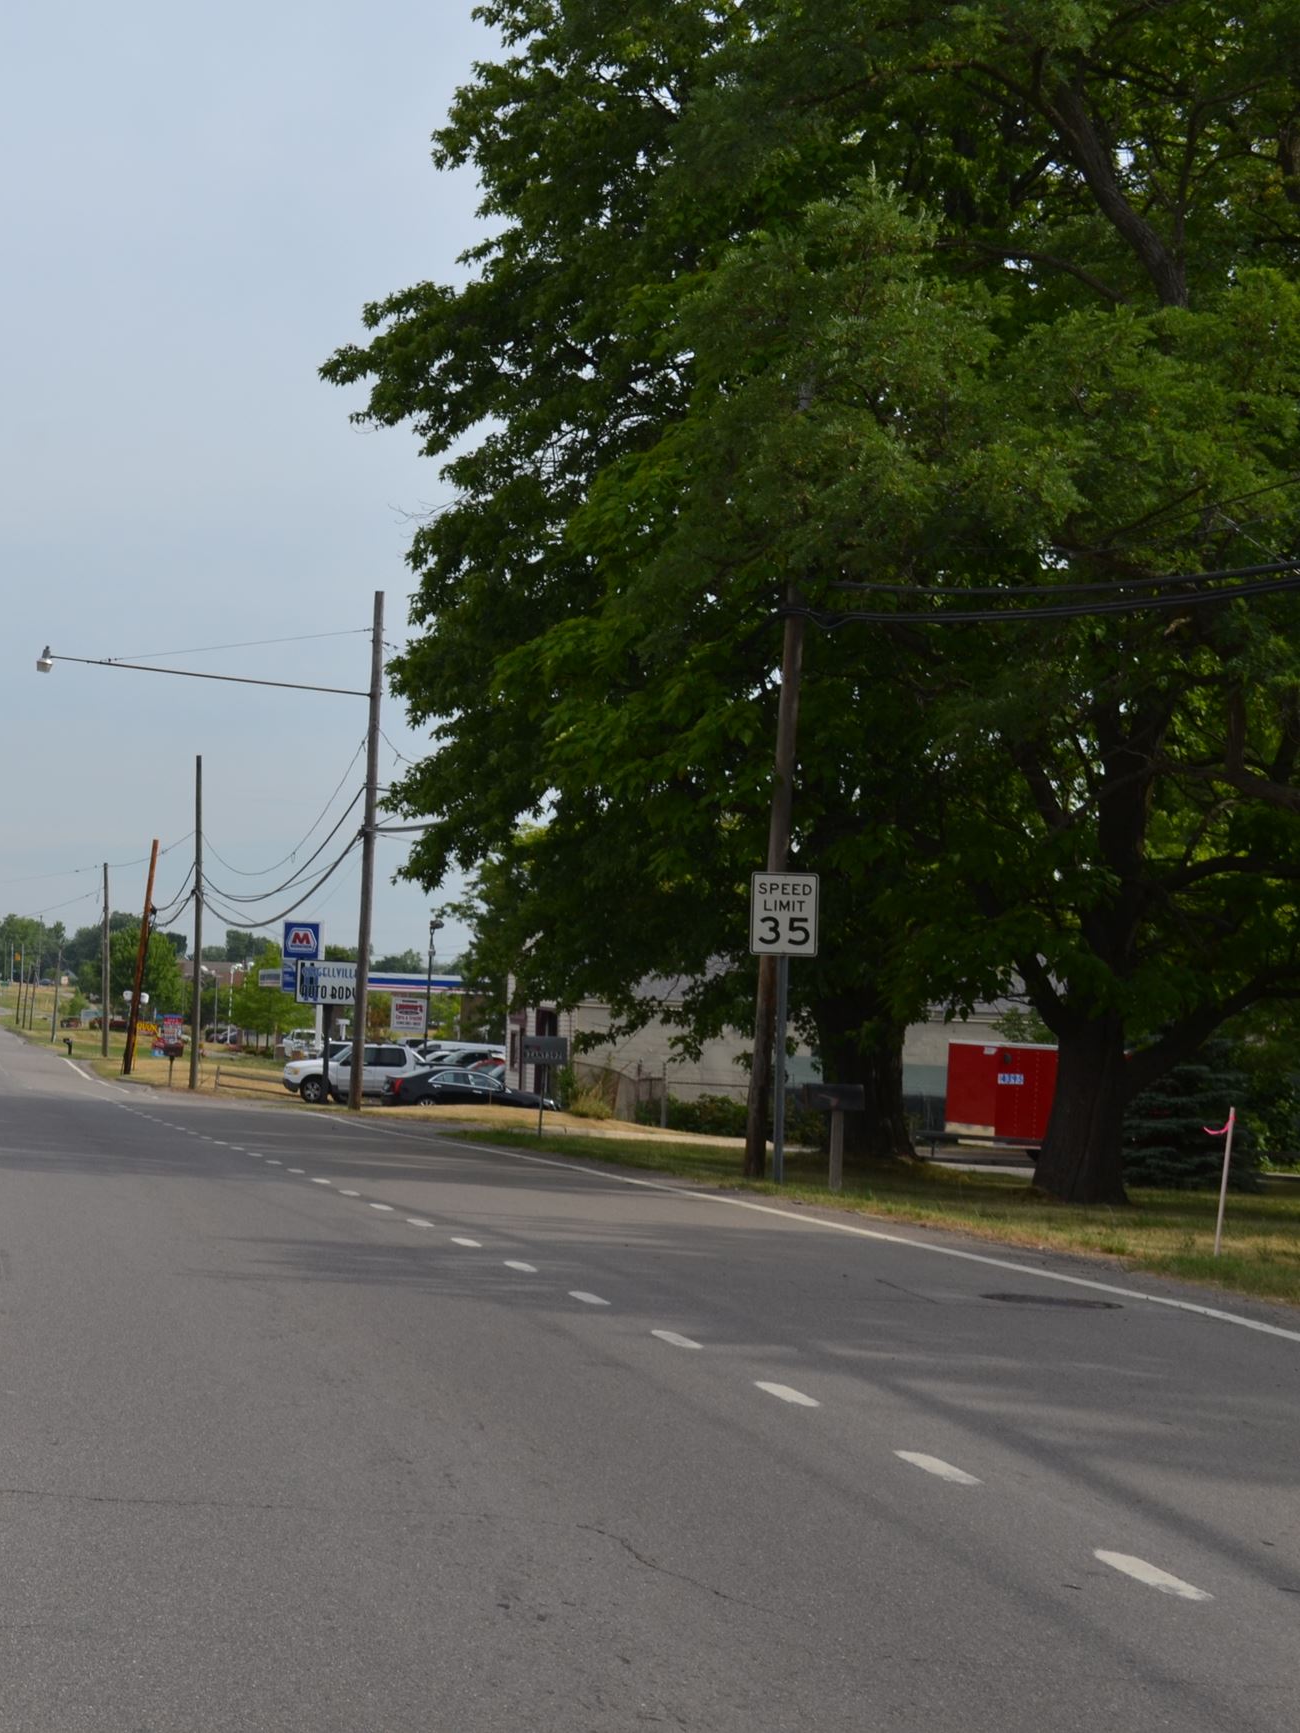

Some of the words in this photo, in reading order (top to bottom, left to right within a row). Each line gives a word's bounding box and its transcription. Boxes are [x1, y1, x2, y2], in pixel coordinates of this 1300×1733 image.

[758, 882, 812, 896] SPEED
[763, 900, 806, 912] LIMIT
[758, 916, 810, 945] 35
[292, 932, 311, 944] M
[300, 984, 327, 999] AUTO
